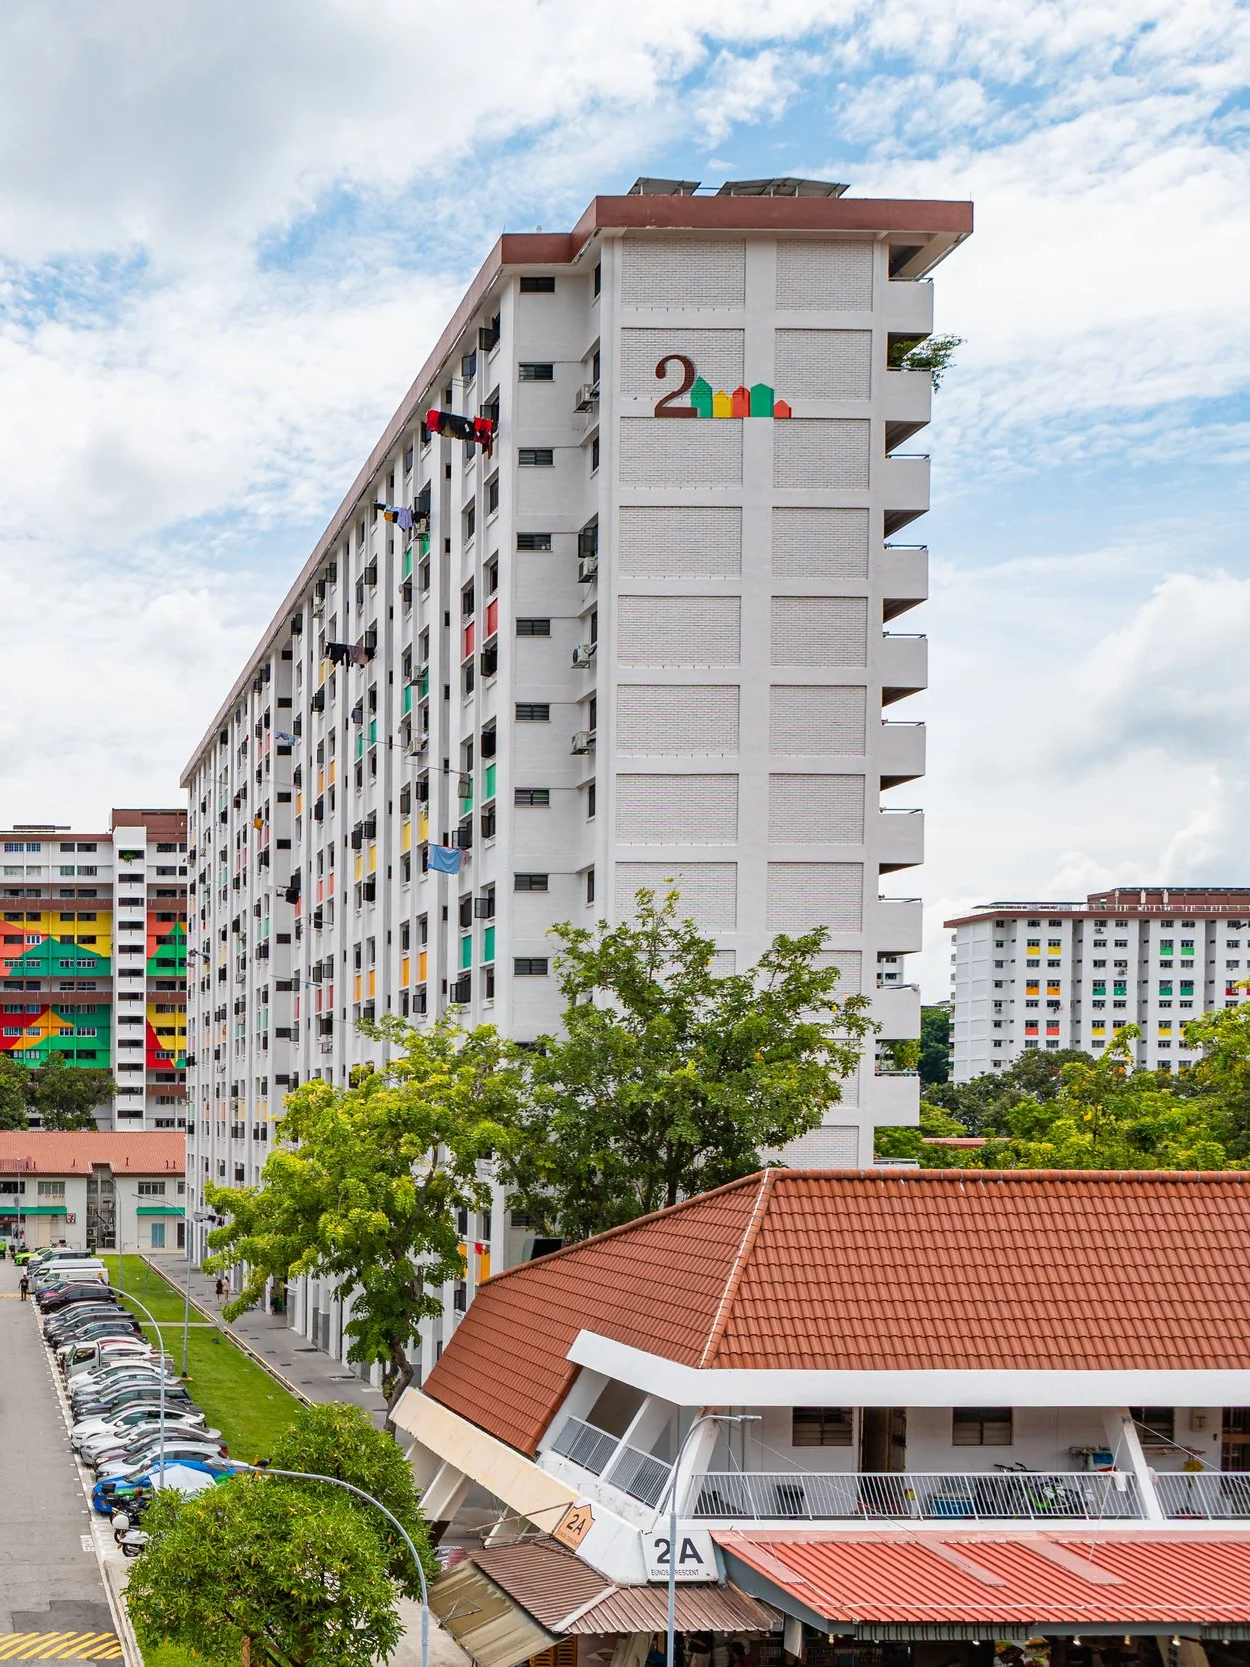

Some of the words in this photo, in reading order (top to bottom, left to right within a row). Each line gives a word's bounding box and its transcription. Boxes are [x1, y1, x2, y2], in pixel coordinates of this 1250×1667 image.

[654, 354, 698, 417] 2
[566, 1513, 587, 1536] 2A
[654, 1537, 704, 1564] 2A
